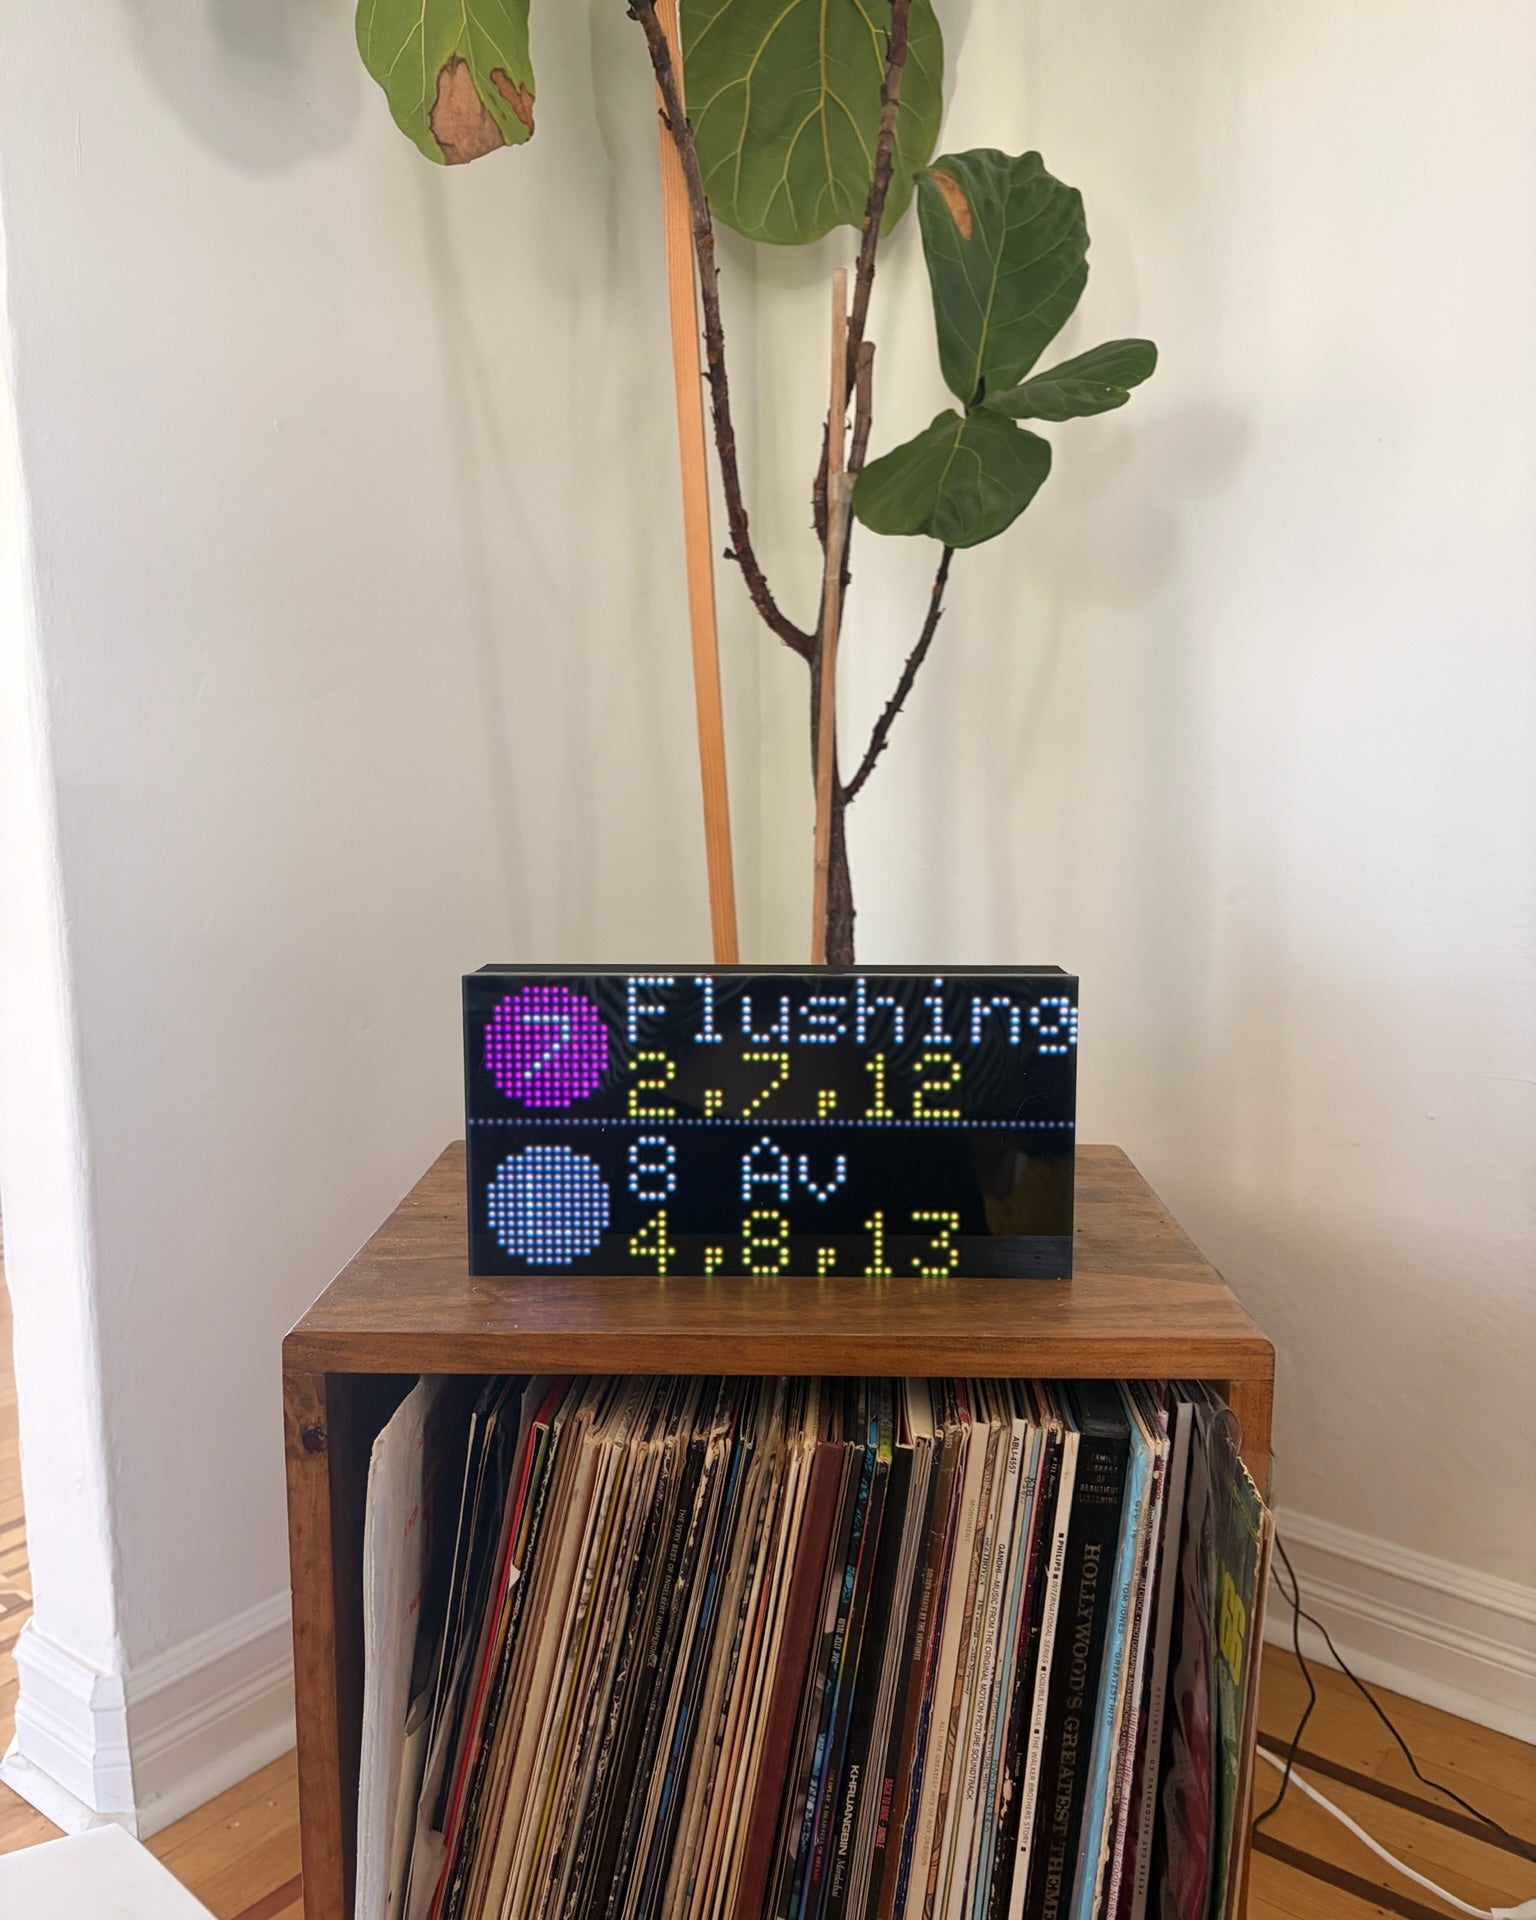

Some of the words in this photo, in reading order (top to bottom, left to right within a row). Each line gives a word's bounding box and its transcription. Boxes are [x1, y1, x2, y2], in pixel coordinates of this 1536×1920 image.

[627, 977, 1079, 1054] Flushing
[522, 1014, 571, 1080] 7
[629, 1136, 677, 1201] 8
[742, 1136, 847, 1202] Av
[676, 1508, 686, 1523] THE
[964, 1499, 976, 1542] MONUMENT
[673, 1523, 683, 1541] VERY
[668, 1543, 679, 1560] BEST
[1053, 1539, 1064, 1572] PHILIPS
[666, 1562, 675, 1573] OF
[1137, 1576, 1145, 1587] JIM
[657, 1573, 672, 1614] ENGELBERT
[1120, 1581, 1129, 1601] TOM
[1134, 1588, 1144, 1616] CROCE
[987, 1606, 997, 1629] FROM
[1045, 1580, 1059, 1639] INTERNATIONAL
[1116, 1603, 1127, 1633] JONES
[985, 1629, 994, 1645] THE
[1065, 1542, 1101, 1710] HOLLYWOOD'S
[1042, 1640, 1052, 1664] SERIES
[1127, 1620, 1140, 1676] PHOTOGRAPHS
[980, 1645, 992, 1683] ORIGINAL
[976, 1683, 987, 1714] MOTION
[1037, 1672, 1048, 1702] DOUBLE
[1125, 1677, 1133, 1695] AND
[938, 1720, 946, 1732] ALL
[1034, 1703, 1044, 1726] VALUE
[1105, 1703, 1115, 1726] HITS
[1120, 1695, 1131, 1732] MEMORIES
[935, 1735, 944, 1752] TIME
[972, 1714, 983, 1747] PICTURE
[1032, 1735, 1040, 1750] THE
[1119, 1736, 1127, 1747] HIS
[1125, 1706, 1138, 1755] SURPRISE
[930, 1753, 942, 1788] GREATEST
[965, 1747, 979, 1800] SOUNDTRACK
[1028, 1751, 1038, 1781] WALKER
[1050, 1715, 1081, 1835] GREATEST
[1114, 1748, 1125, 1786] GREATEST
[1122, 1758, 1132, 1785] CHEF
[837, 1764, 860, 1855] KHRUANGBIN
[926, 1807, 934, 1816] OF
[928, 1790, 936, 1805] HITS
[1023, 1782, 1034, 1819] BROTHERS
[1119, 1794, 1128, 1812] ALL
[924, 1819, 932, 1833] ROY
[1020, 1820, 1030, 1844] STORY
[1115, 1817, 1126, 1845] NEWS
[920, 1834, 930, 1865] ORBISON
[1114, 1847, 1122, 1856] IS
[1111, 1860, 1121, 1886] GOOD
[1107, 1889, 1118, 1917] NEWS
